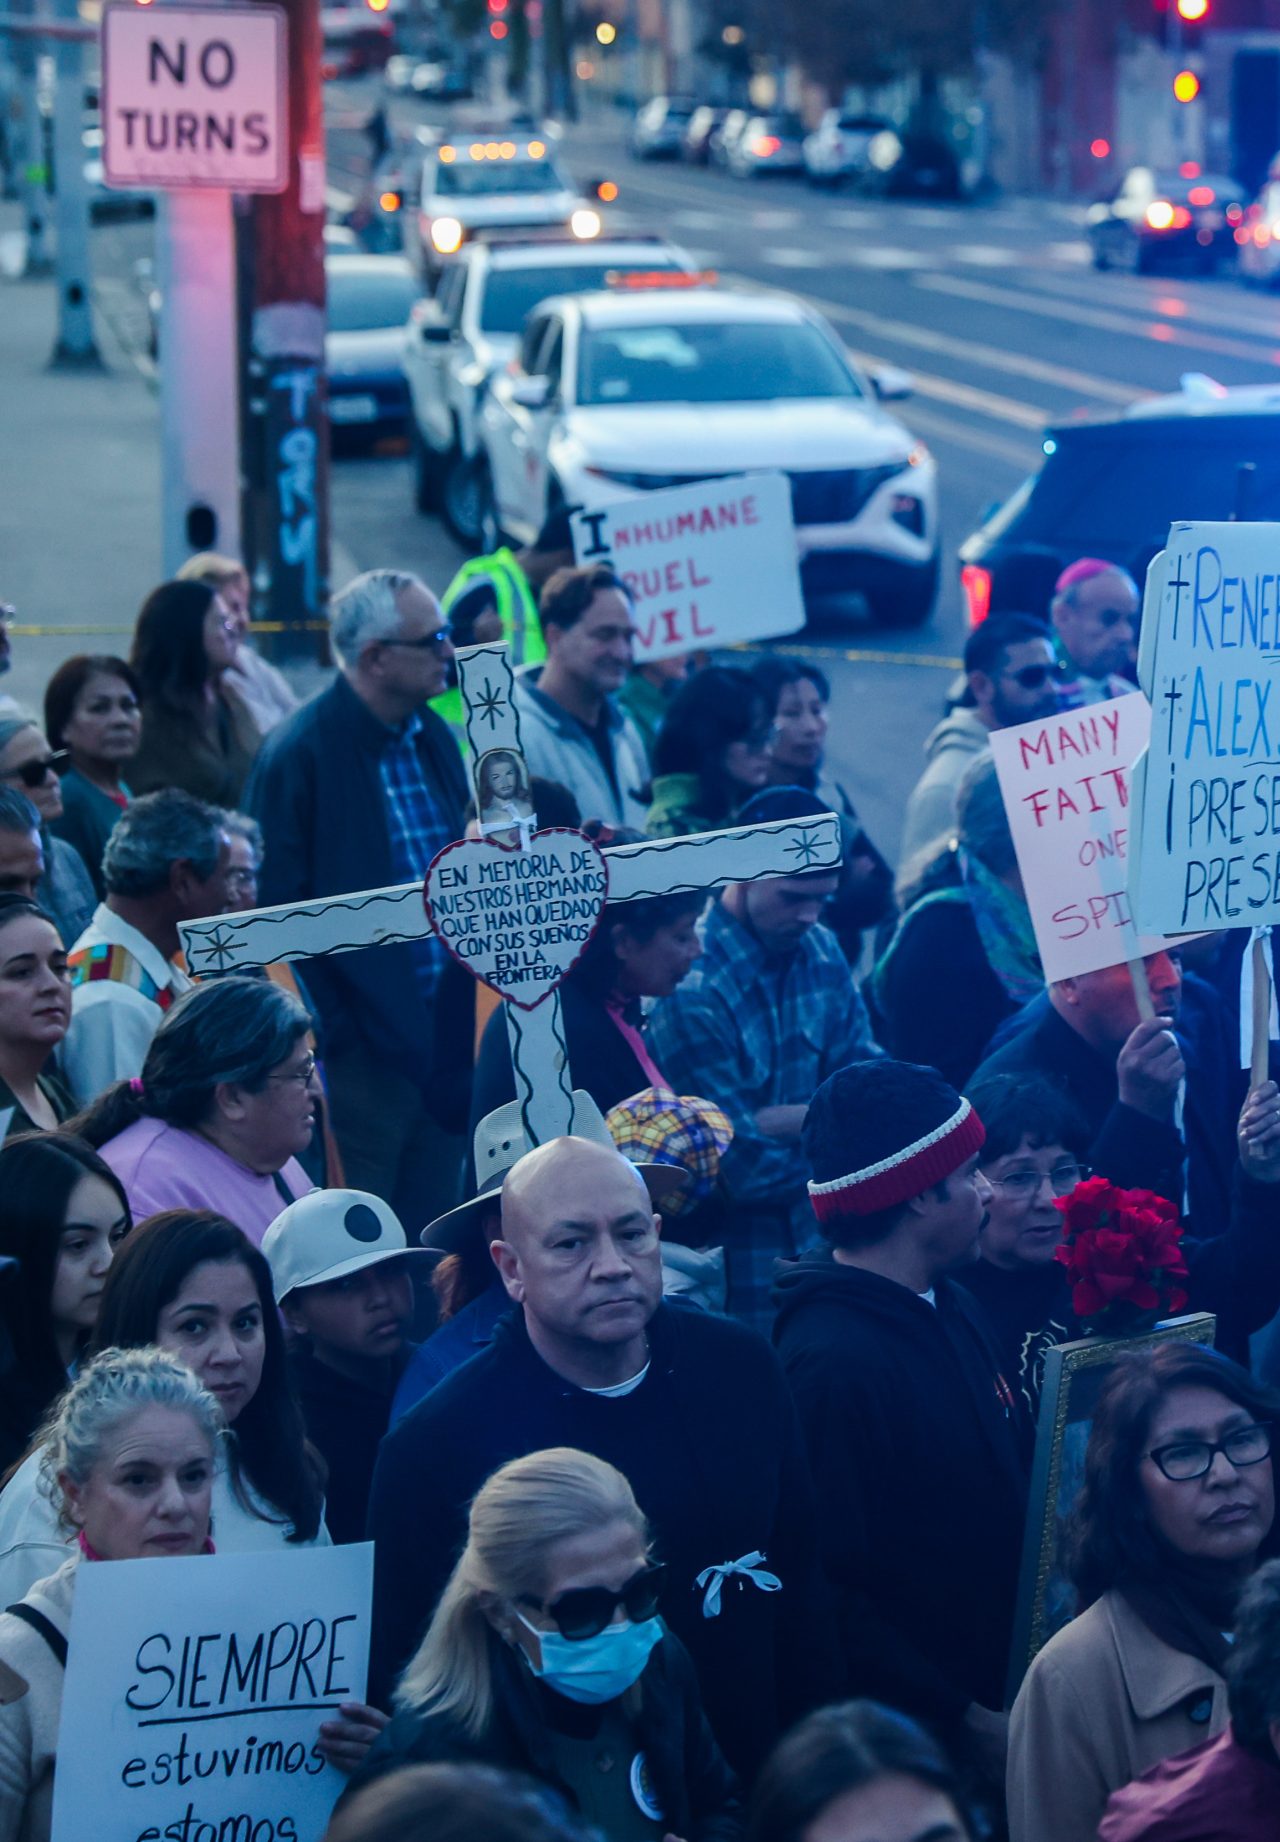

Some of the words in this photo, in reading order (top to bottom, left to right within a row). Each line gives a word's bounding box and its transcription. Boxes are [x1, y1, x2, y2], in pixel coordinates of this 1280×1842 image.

[149, 38, 236, 89] NO
[118, 109, 270, 156] TURNS
[580, 495, 760, 557] INHUMANE
[602, 557, 712, 603] RUEL
[634, 602, 716, 649] VIL
[1184, 665, 1271, 760] ALEX
[1018, 709, 1119, 770] MANY
[1021, 766, 1129, 828] FAIT
[438, 865, 468, 889] EN
[479, 853, 565, 884] MEMORIA
[571, 849, 595, 874] DE
[1078, 828, 1127, 867] ONE
[428, 884, 512, 919] NUESTROS
[514, 871, 606, 905] HERMANOS
[440, 914, 480, 938] QUE
[485, 908, 523, 931] HAN
[525, 897, 601, 926] QUEDADO
[1051, 890, 1131, 940] SPI
[455, 934, 492, 958] CON
[494, 930, 525, 953] SUS
[529, 922, 590, 949] SUEÑOS
[495, 951, 519, 970] EN
[523, 949, 547, 966] LA
[485, 964, 564, 986] FRONTERA
[125, 1614, 357, 1711] SIEMPRE
[121, 1731, 326, 1788] estuvimos
